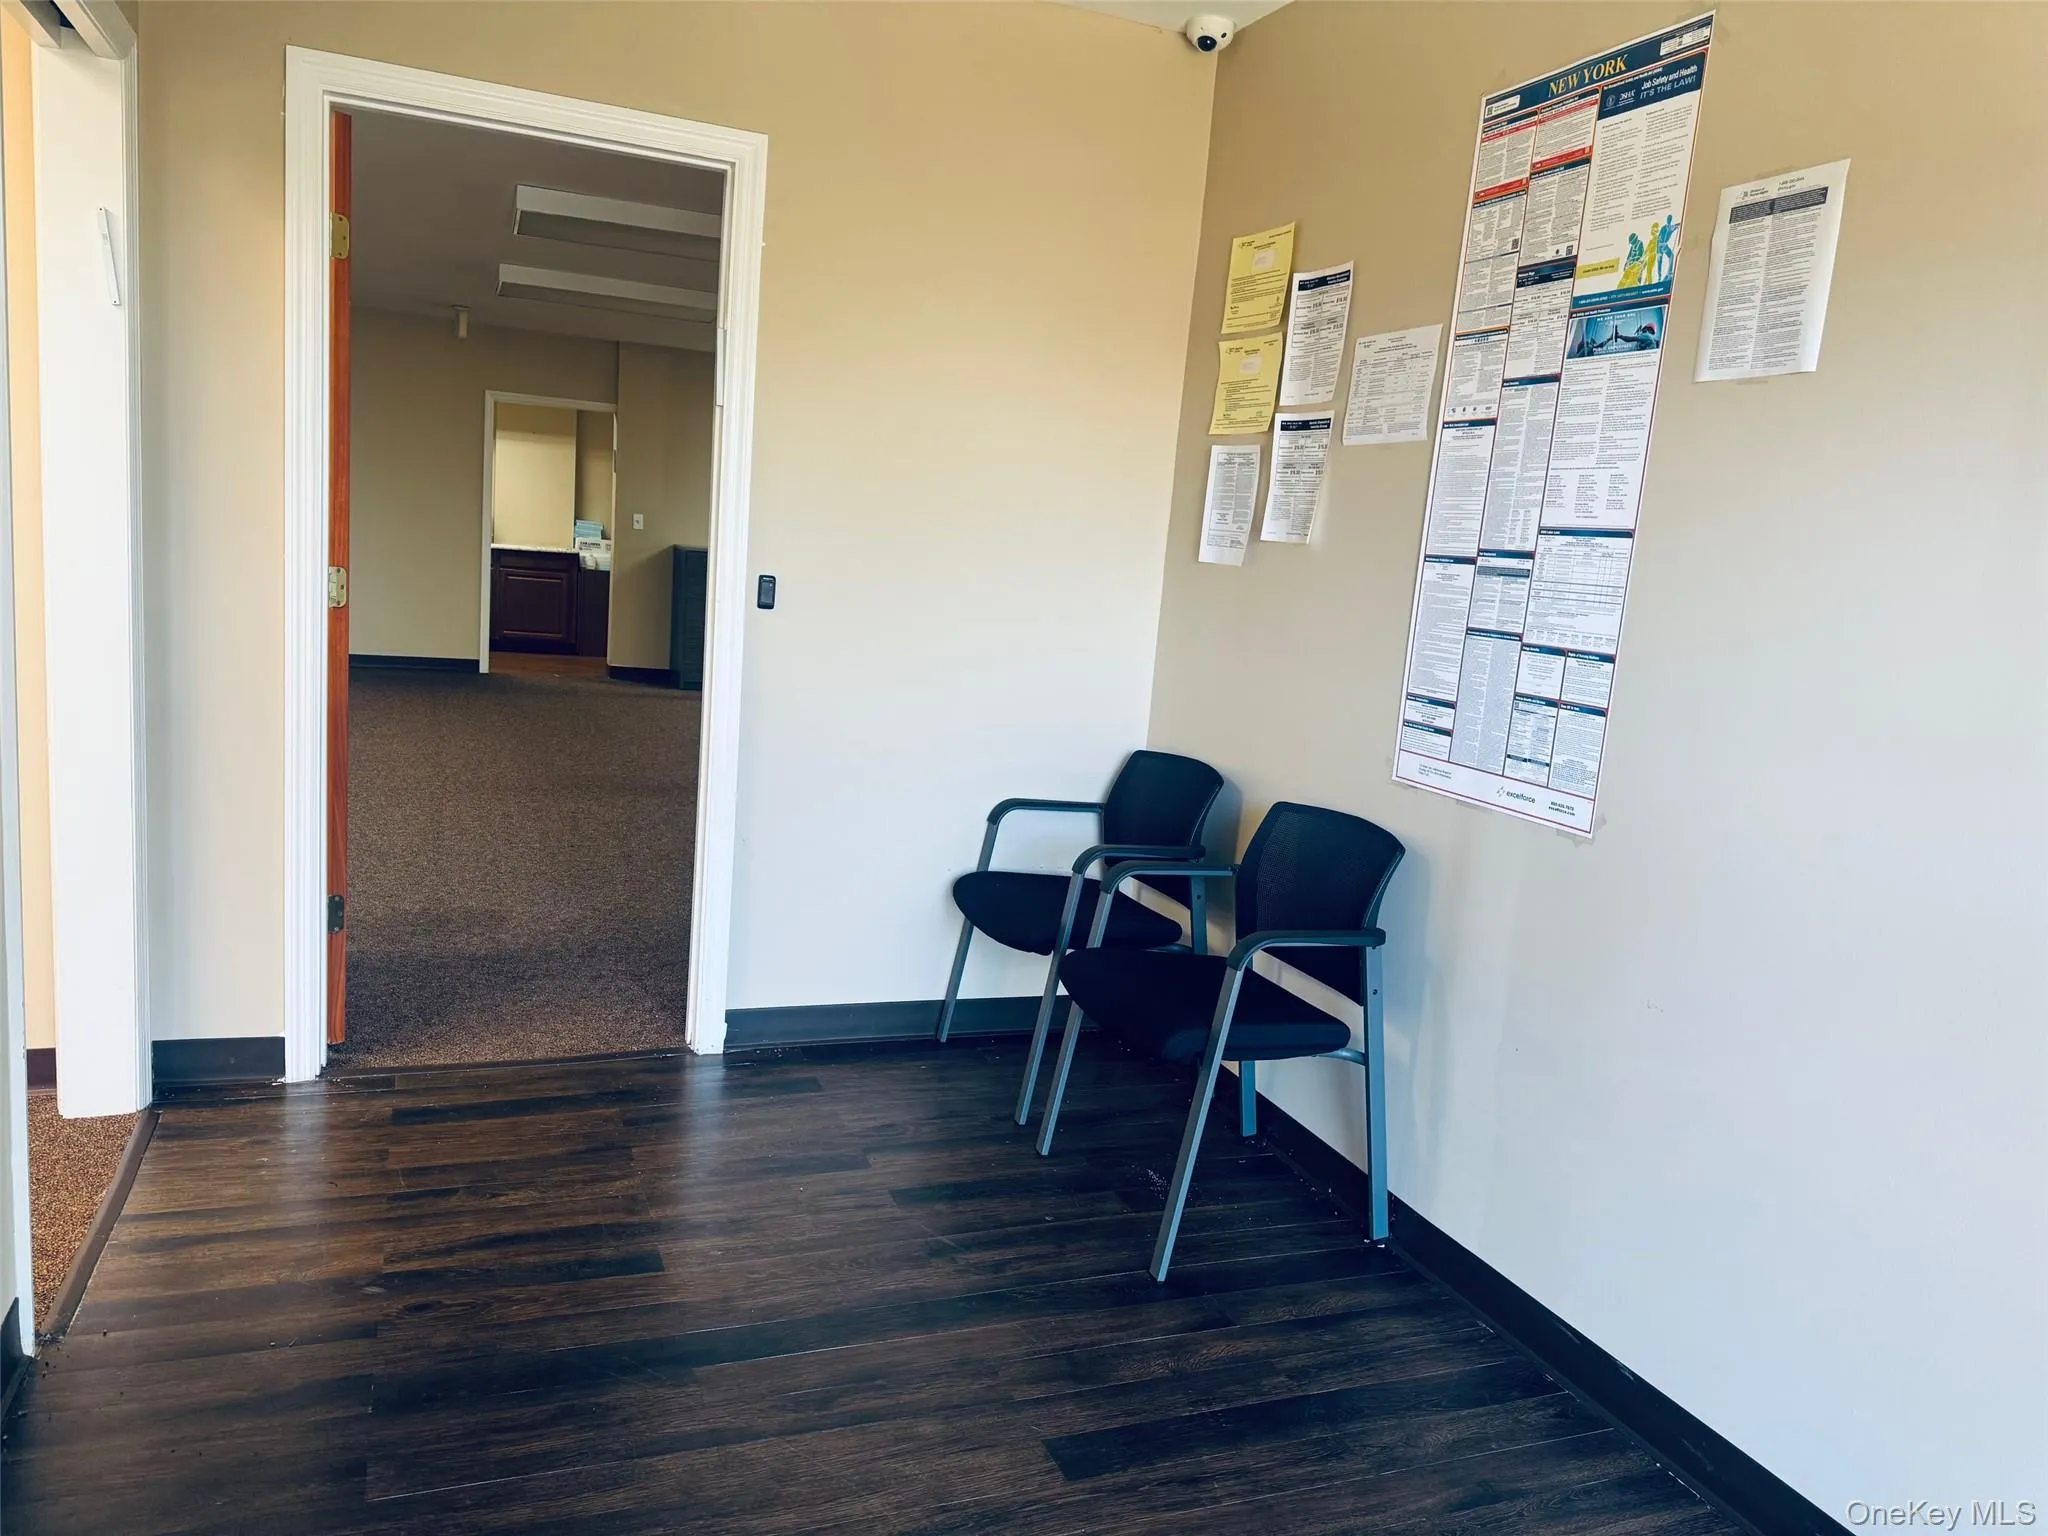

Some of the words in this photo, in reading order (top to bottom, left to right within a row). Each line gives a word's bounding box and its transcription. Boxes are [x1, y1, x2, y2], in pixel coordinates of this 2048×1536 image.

[1548, 71, 1581, 98] NEW
[1584, 54, 1629, 84] YORK
[1640, 89, 1655, 99] IT'S
[1657, 82, 1672, 93] THE
[1674, 74, 1697, 88] LAW!
[1641, 80, 1652, 90] Job
[1652, 75, 1669, 87] Safety
[1669, 70, 1680, 81] and
[1680, 64, 1698, 78] Health
[1506, 791, 1536, 804] excelforce
